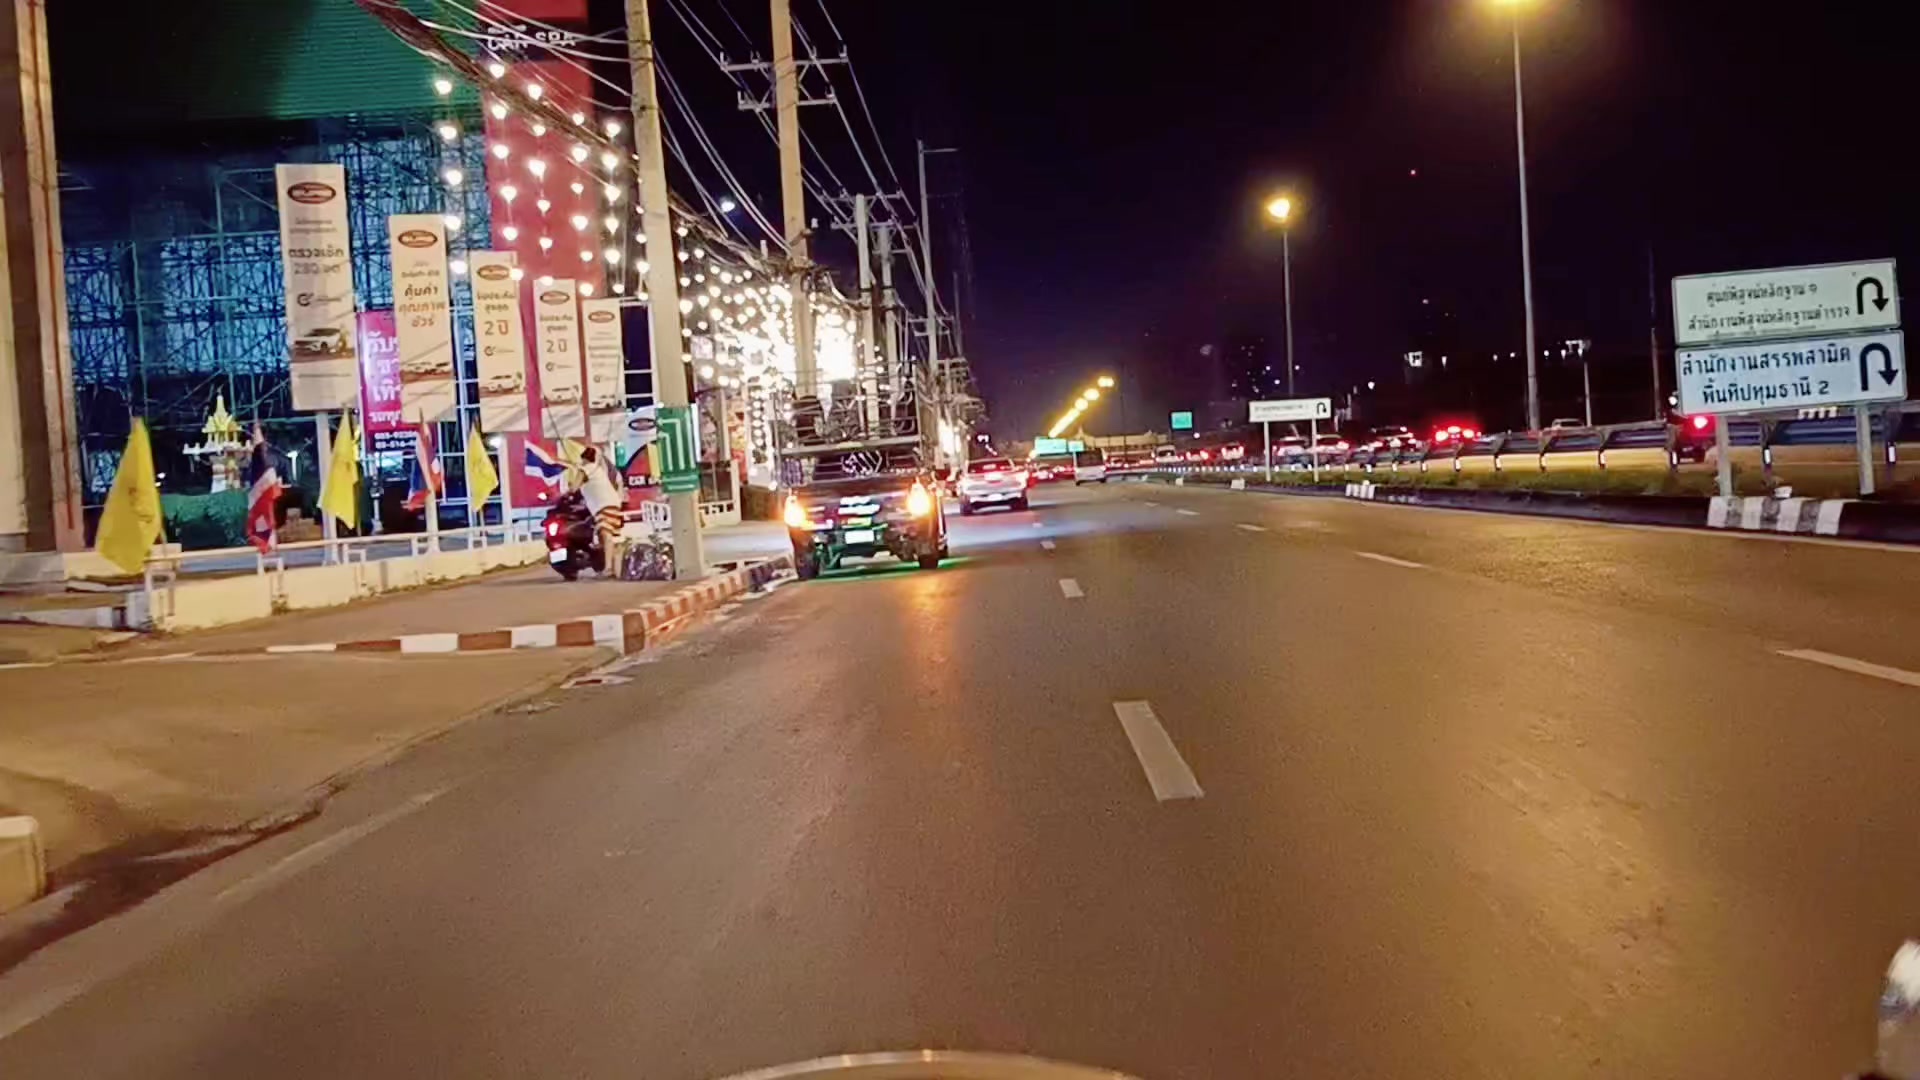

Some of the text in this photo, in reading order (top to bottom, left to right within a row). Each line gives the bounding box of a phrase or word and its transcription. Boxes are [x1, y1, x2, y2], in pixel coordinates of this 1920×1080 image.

[484, 321, 494, 336] 2
[546, 340, 554, 354] 2
[1818, 380, 1830, 396] 2
